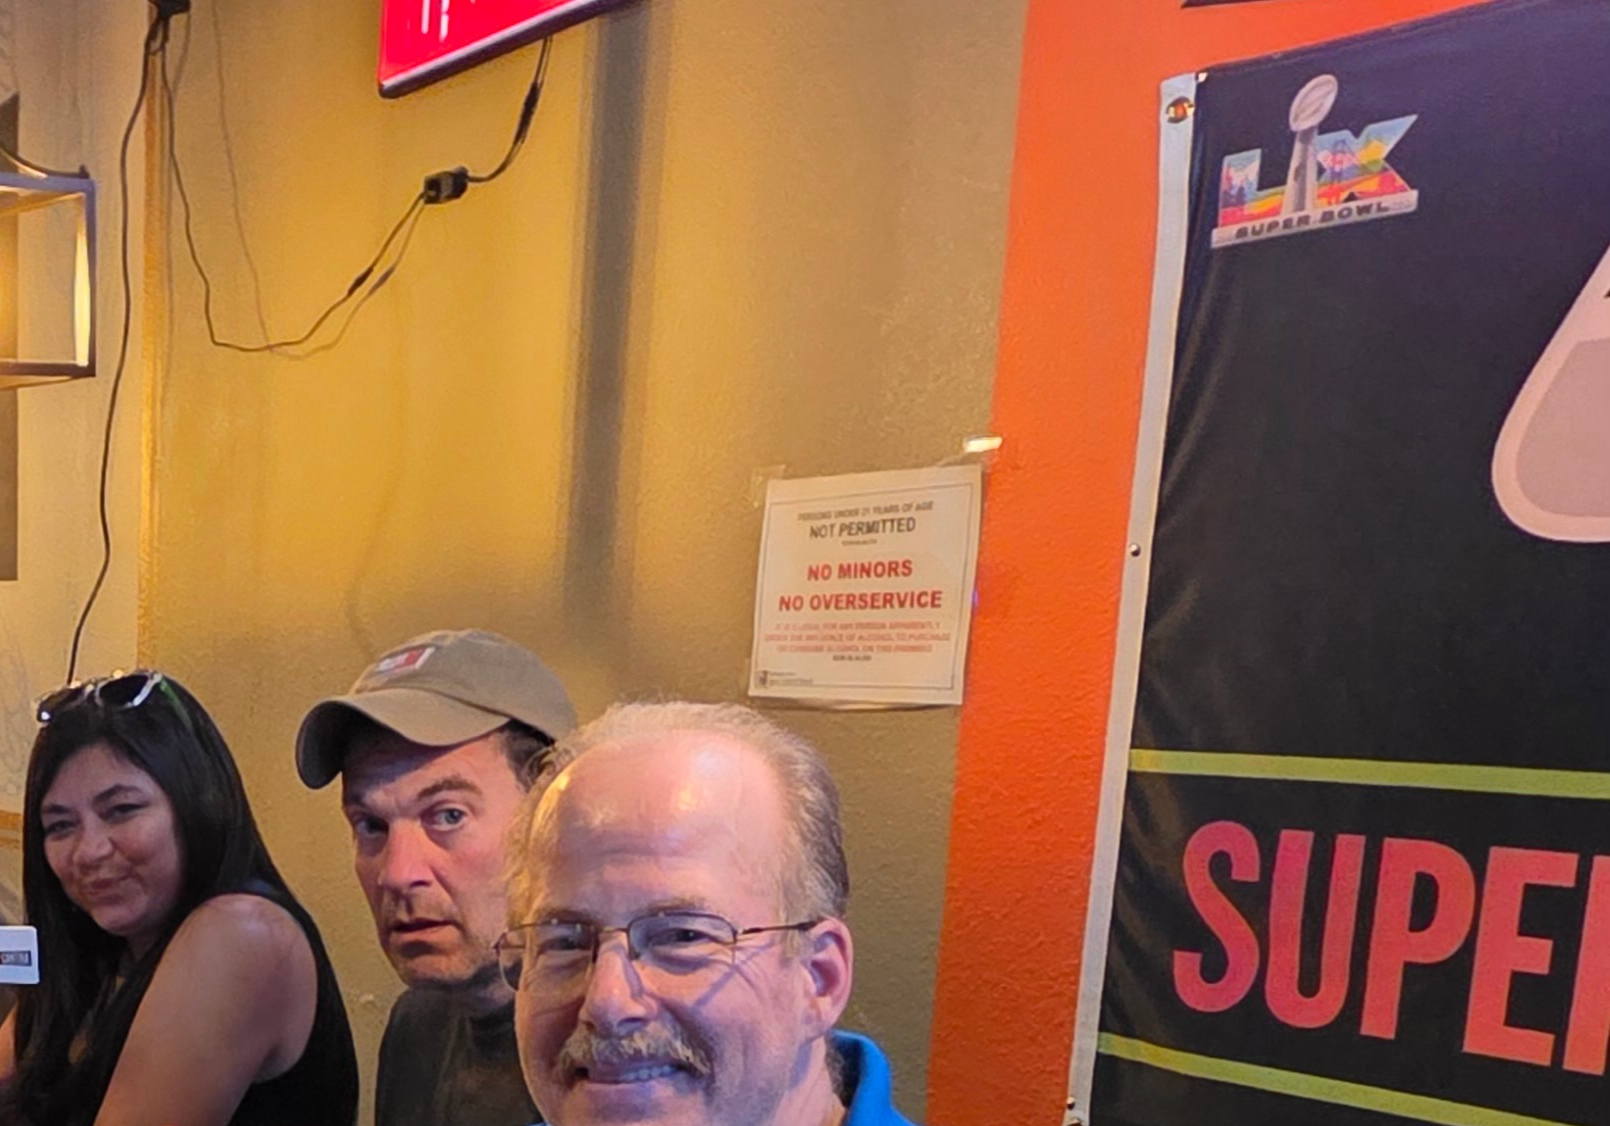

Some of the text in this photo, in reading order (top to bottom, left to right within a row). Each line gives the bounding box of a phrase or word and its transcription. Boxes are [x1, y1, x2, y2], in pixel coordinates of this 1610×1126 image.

[1236, 202, 1389, 239] SUPER BOWL
[902, 503, 913, 513] OF
[810, 517, 915, 539] NOT PERMITTED
[807, 559, 913, 581] NO MINORS
[779, 591, 943, 612] NO OVERSERVICE
